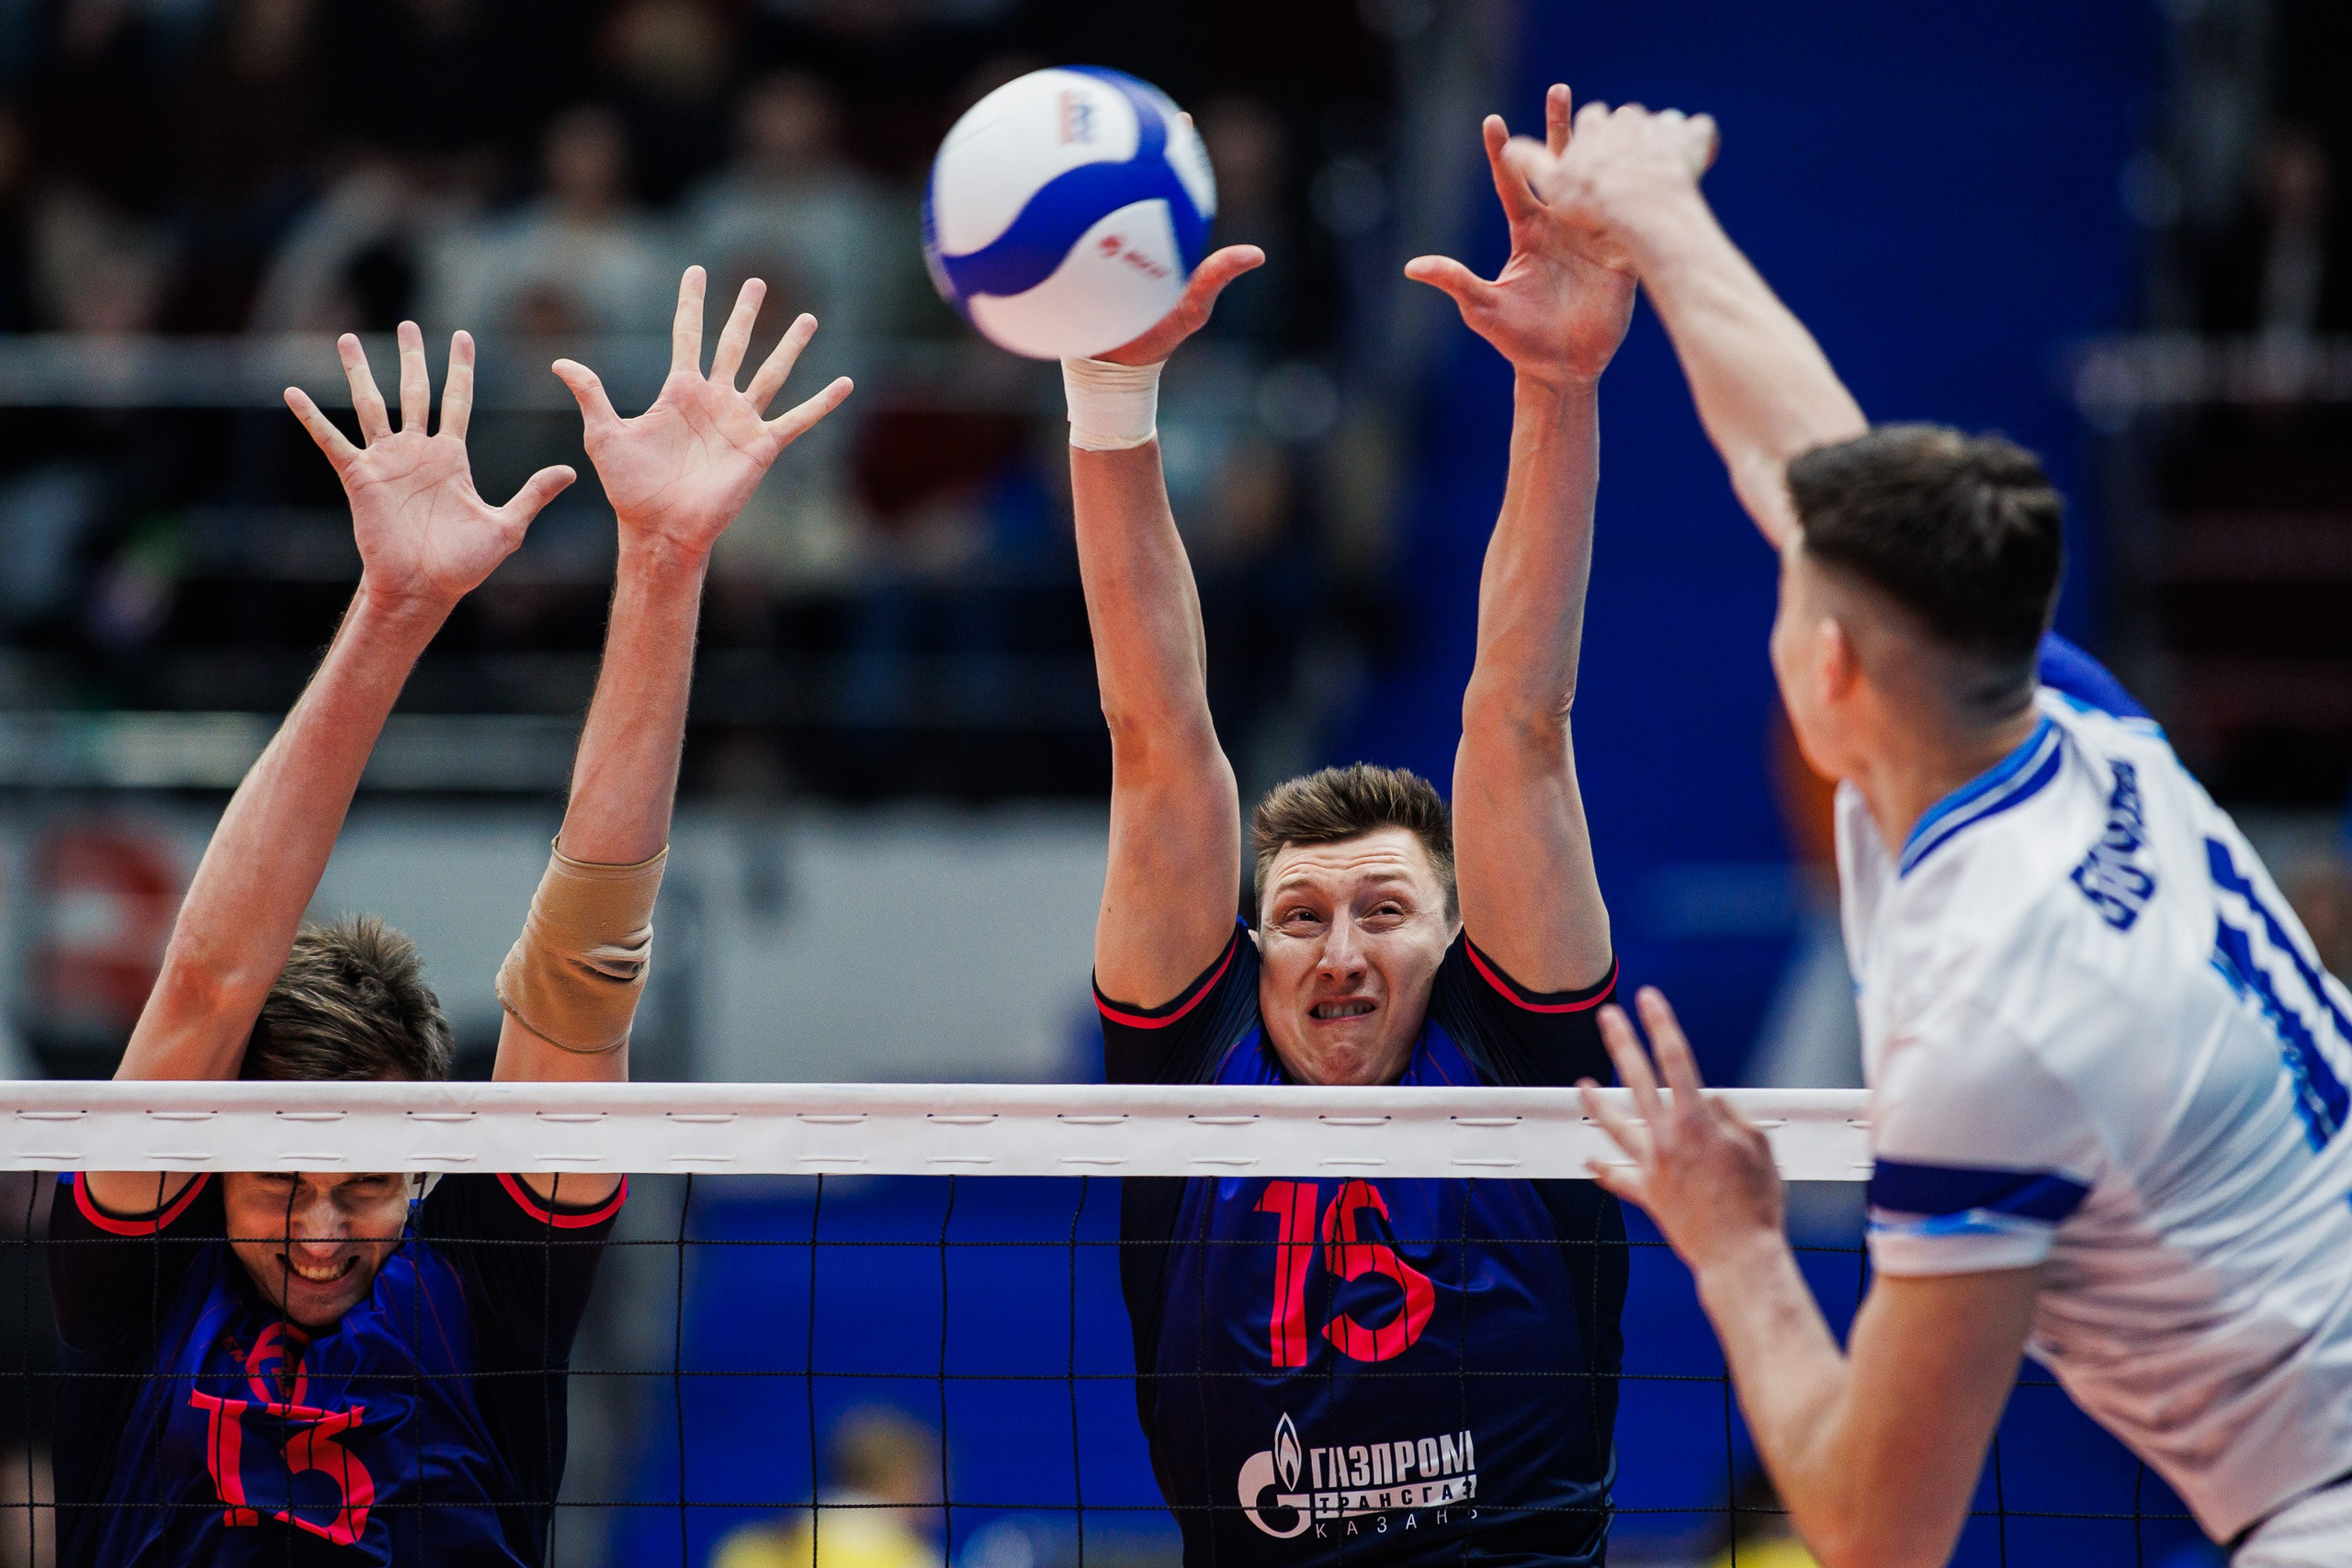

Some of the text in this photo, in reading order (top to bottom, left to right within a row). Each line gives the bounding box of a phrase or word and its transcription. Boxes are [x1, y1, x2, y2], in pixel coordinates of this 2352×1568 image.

[1254, 1180, 1435, 1367] 15
[188, 1389, 375, 1546] 13
[1310, 1430, 1475, 1489] ГАЗПРОМ
[1318, 1480, 1474, 1514] ТРАНСГАЗ
